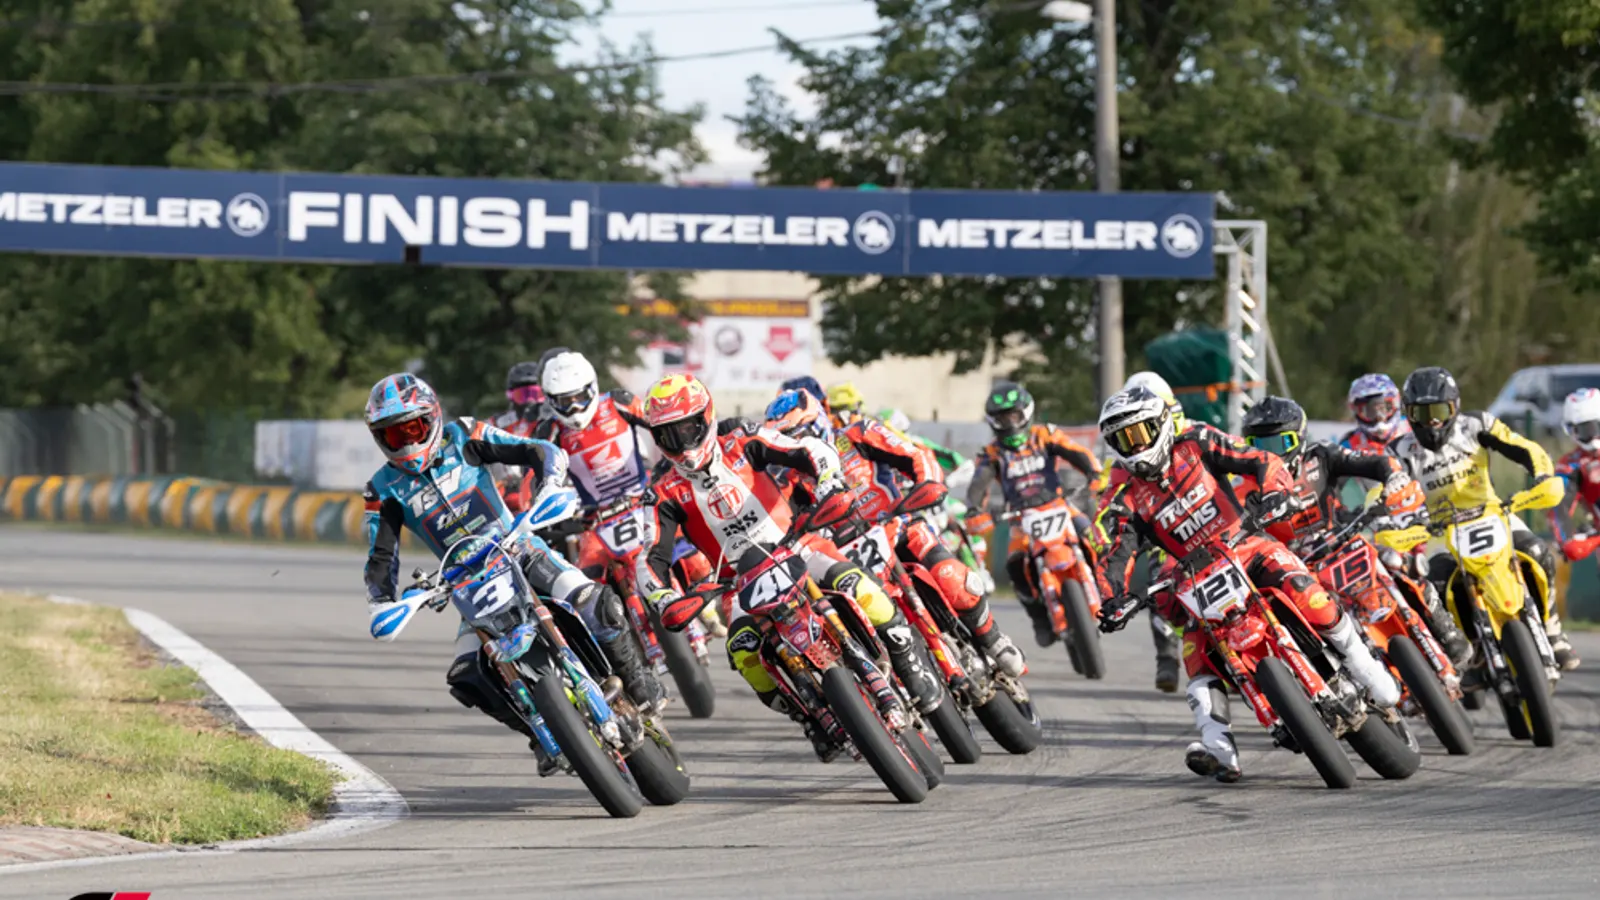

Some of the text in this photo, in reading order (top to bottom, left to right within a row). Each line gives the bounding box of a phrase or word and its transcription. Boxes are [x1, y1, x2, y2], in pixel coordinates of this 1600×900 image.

[288, 191, 590, 250] FINISH
[607, 212, 849, 246] METZELER
[918, 219, 1157, 250] METZELER
[613, 518, 638, 547] 6
[1031, 511, 1067, 539] 677
[1173, 500, 1218, 542] TMS
[1469, 525, 1494, 555] 5
[749, 561, 793, 609] 41
[1192, 567, 1242, 612] 121
[1331, 547, 1370, 592] 15
[472, 570, 516, 618] 3
